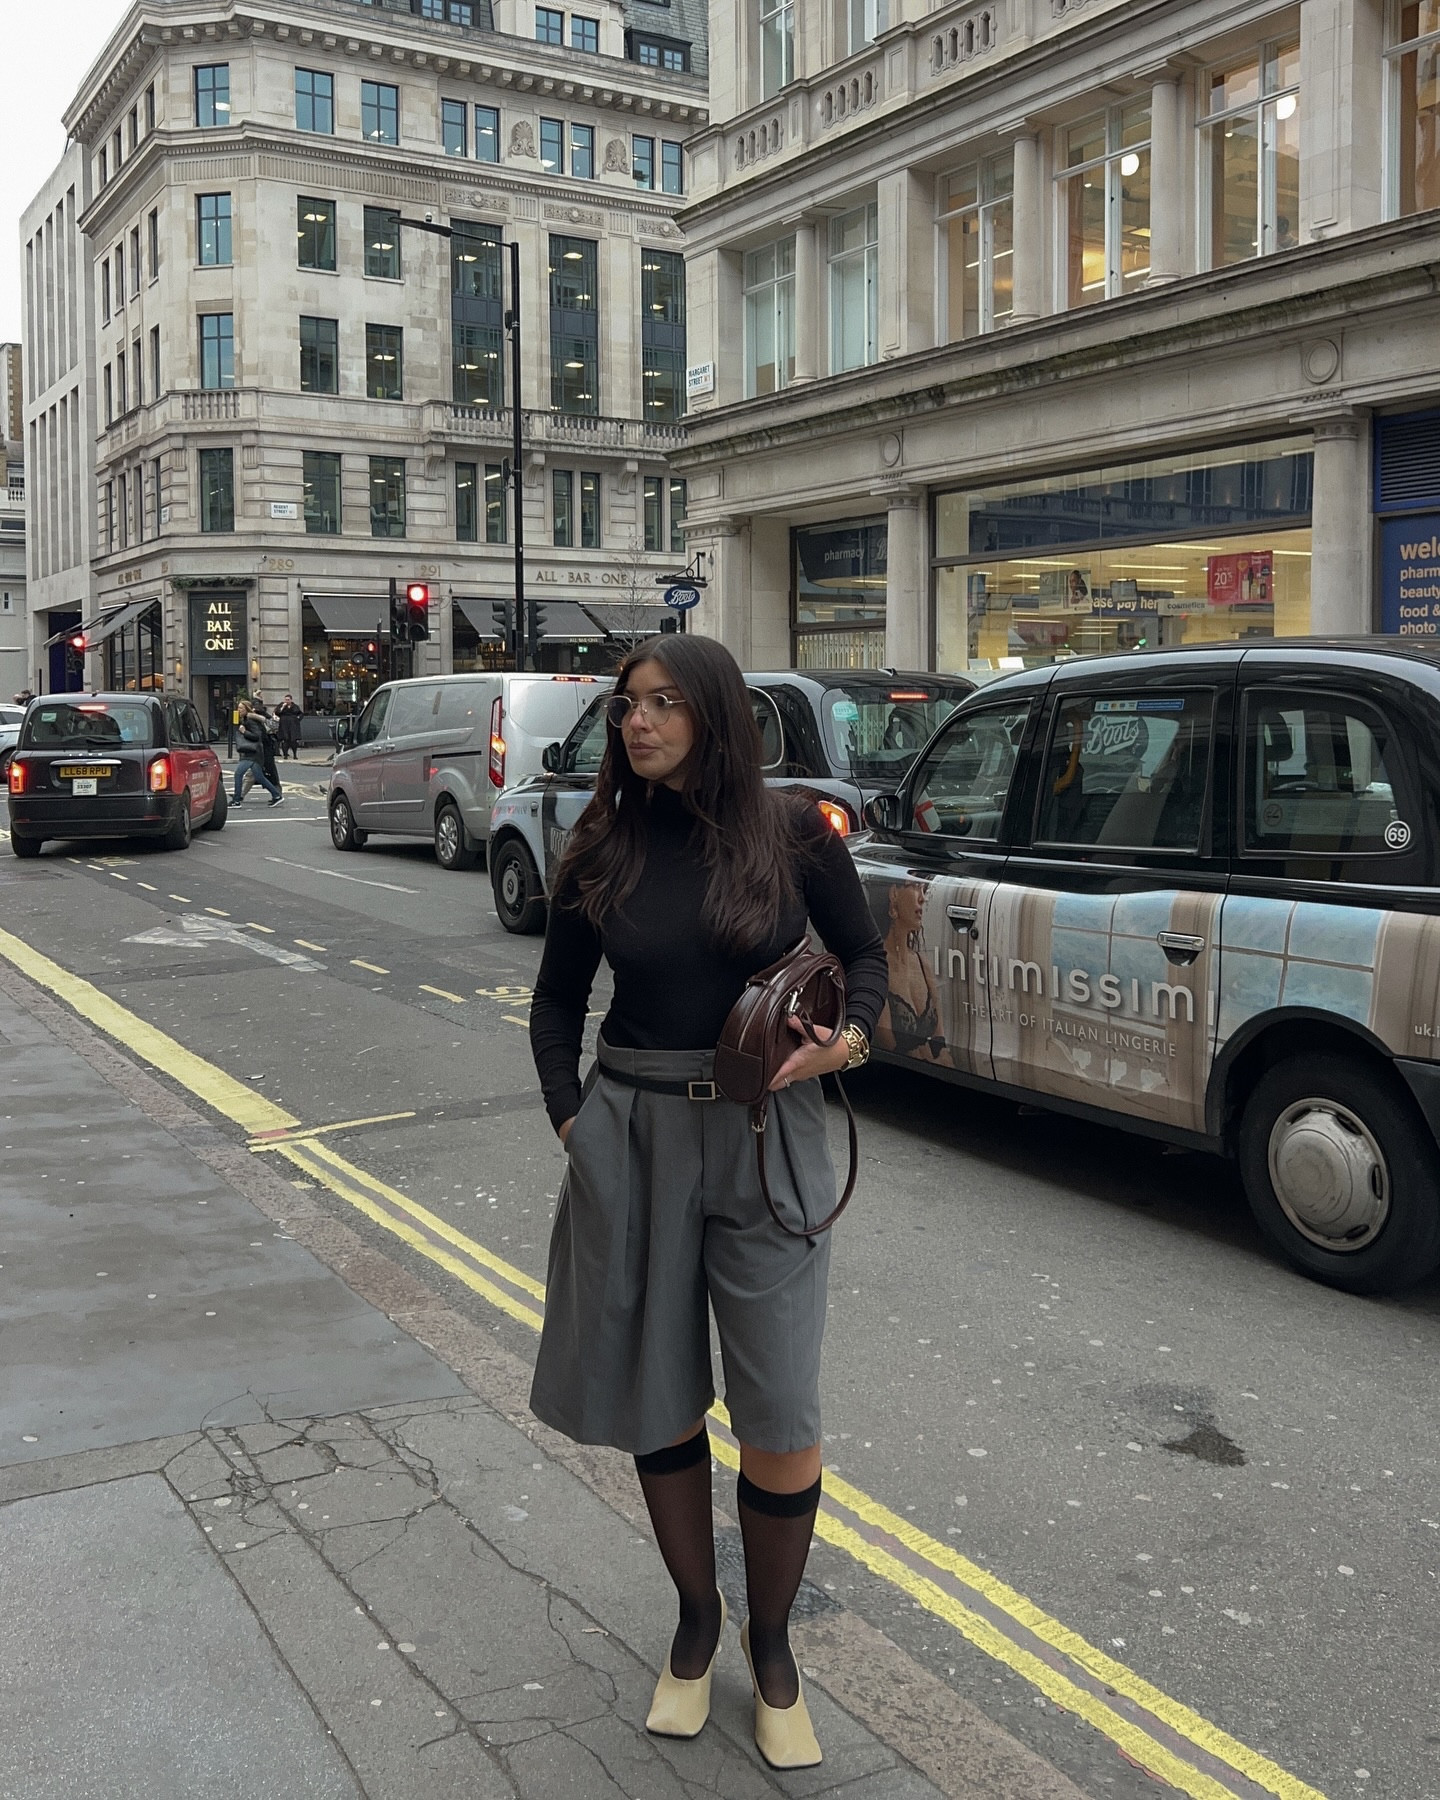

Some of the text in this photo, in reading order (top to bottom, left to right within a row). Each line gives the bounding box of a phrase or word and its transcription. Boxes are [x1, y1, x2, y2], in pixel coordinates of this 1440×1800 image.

[689, 365, 710, 377] MARGARET
[689, 376, 703, 387] STREET
[1400, 536, 1440, 560] wel
[824, 548, 865, 563] pharmacy
[269, 559, 294, 571] 289
[421, 565, 441, 577] 291
[536, 571, 628, 585] ALL BAR ONE
[668, 589, 696, 605] Boots
[1091, 597, 1113, 608] ase
[208, 603, 232, 614] ALL
[1400, 603, 1429, 618] food
[206, 621, 233, 632] BAR
[1400, 621, 1437, 635] photo
[205, 638, 234, 650] ONE
[1082, 715, 1140, 756] Boots
[64, 767, 108, 776] LL68 RPU
[1387, 827, 1408, 842] 69
[934, 945, 1216, 1026] intimissimi
[963, 1001, 1177, 1057] THE ART OF ITALIAN LINGERIE
